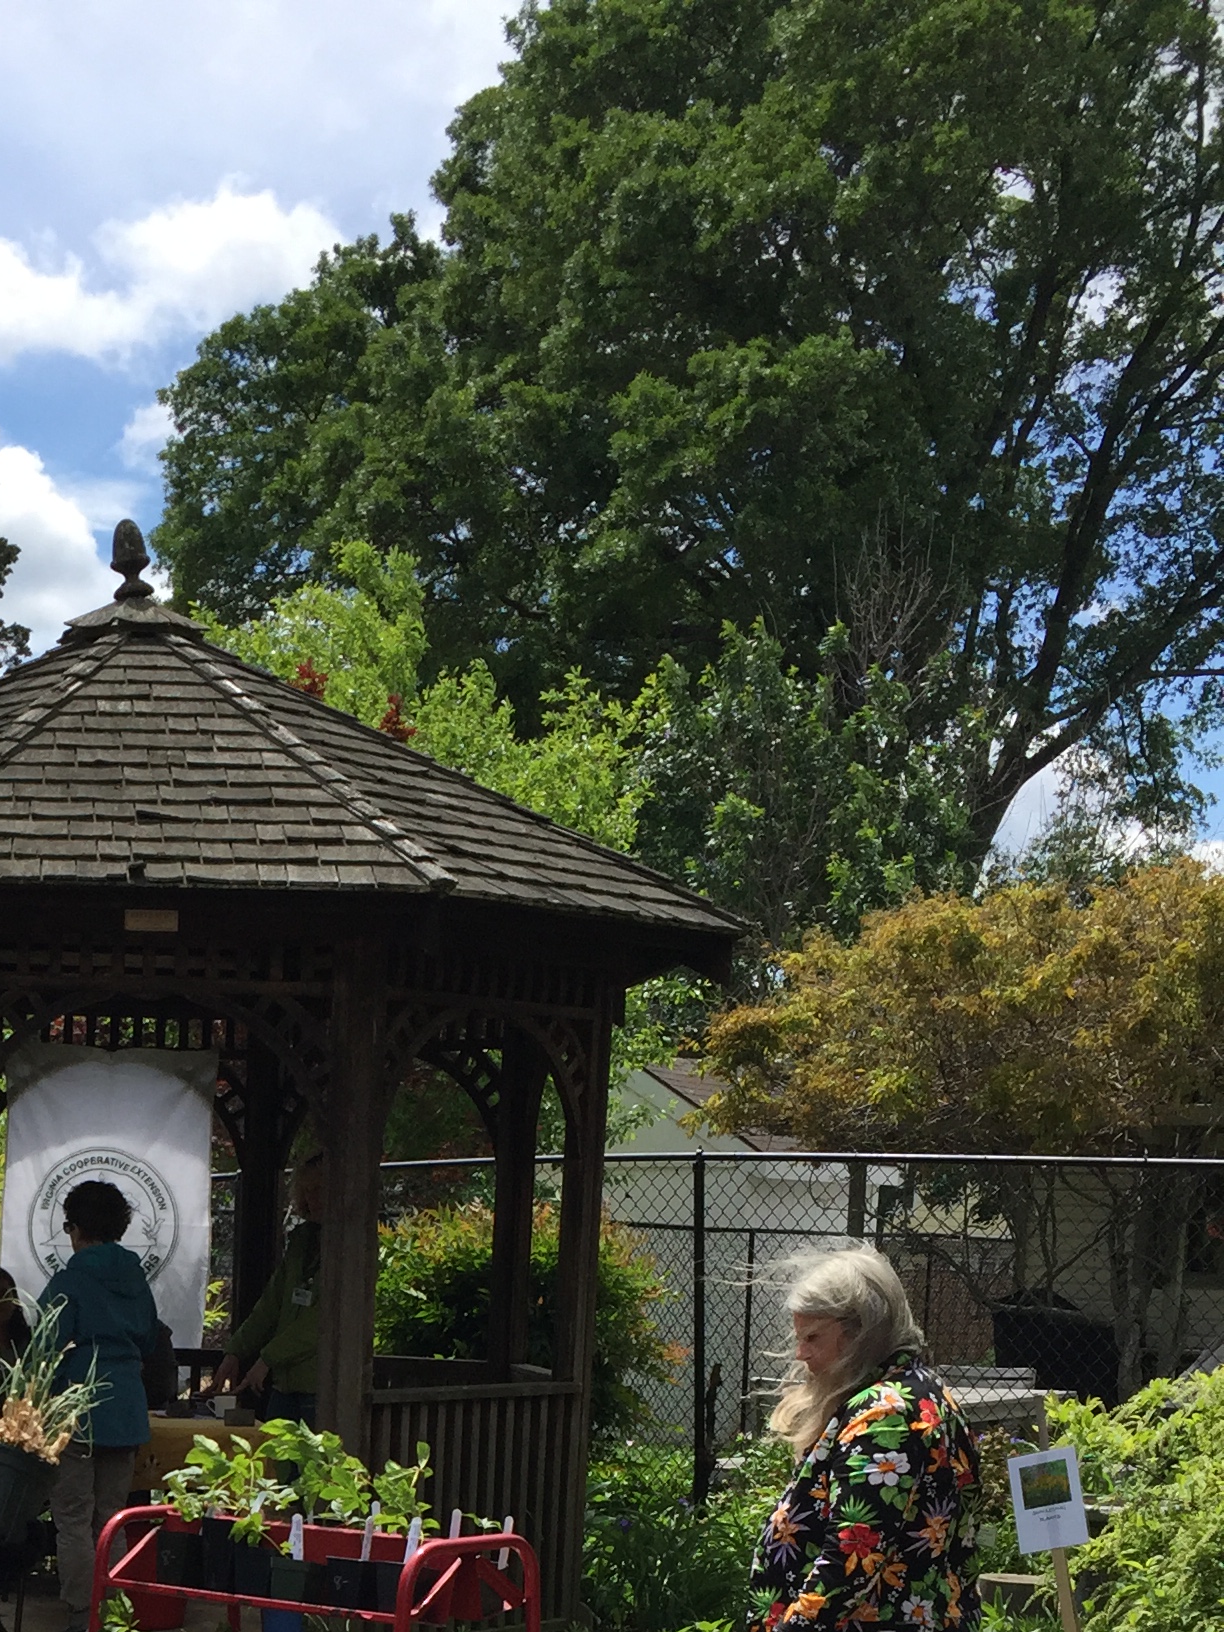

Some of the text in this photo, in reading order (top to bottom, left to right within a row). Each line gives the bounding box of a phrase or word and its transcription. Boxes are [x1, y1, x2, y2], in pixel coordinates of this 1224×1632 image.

[40, 1156, 167, 1211] VIRGINIA COOPERATIVE EXTENSION
